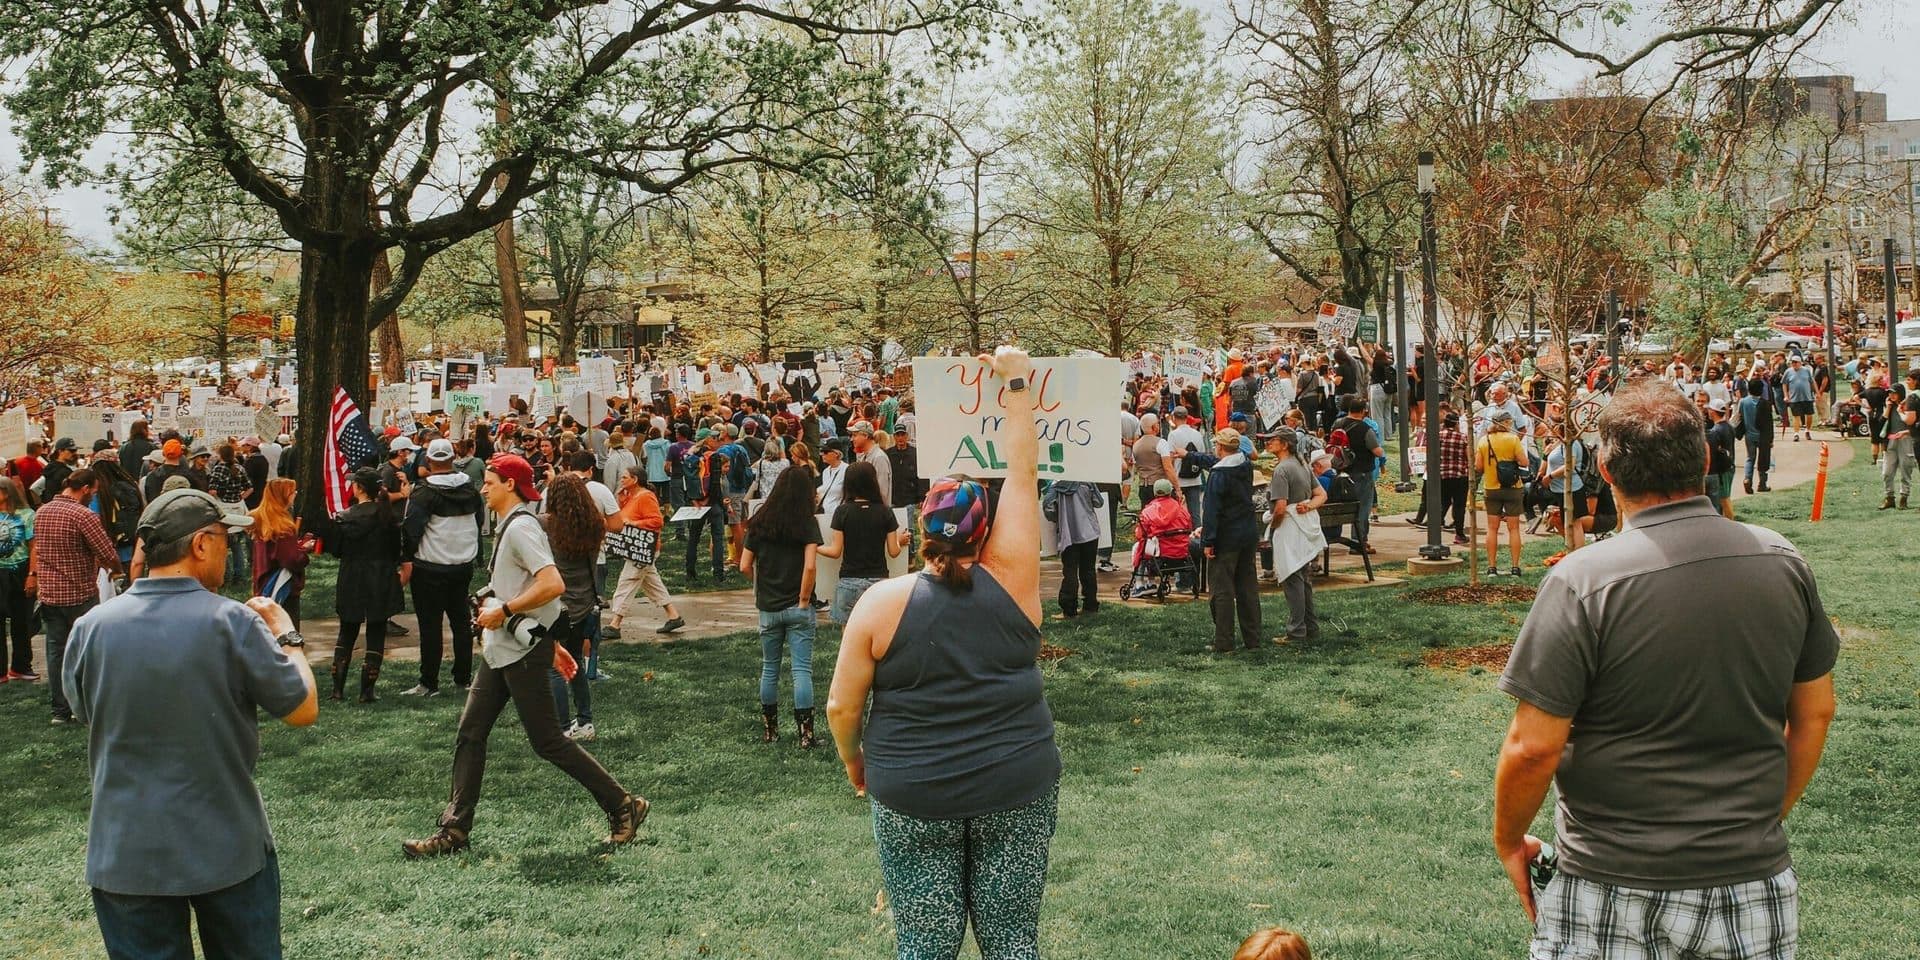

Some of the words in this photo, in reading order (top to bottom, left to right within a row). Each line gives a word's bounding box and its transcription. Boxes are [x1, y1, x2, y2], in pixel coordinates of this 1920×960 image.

[981, 415, 1092, 446] mans
[949, 434, 1065, 473] AL!
[624, 536, 633, 544] TO
[634, 539, 649, 548] GET
[629, 545, 652, 557] CLASS
[612, 546, 629, 558] YOUR
[631, 553, 652, 564] BILLS
